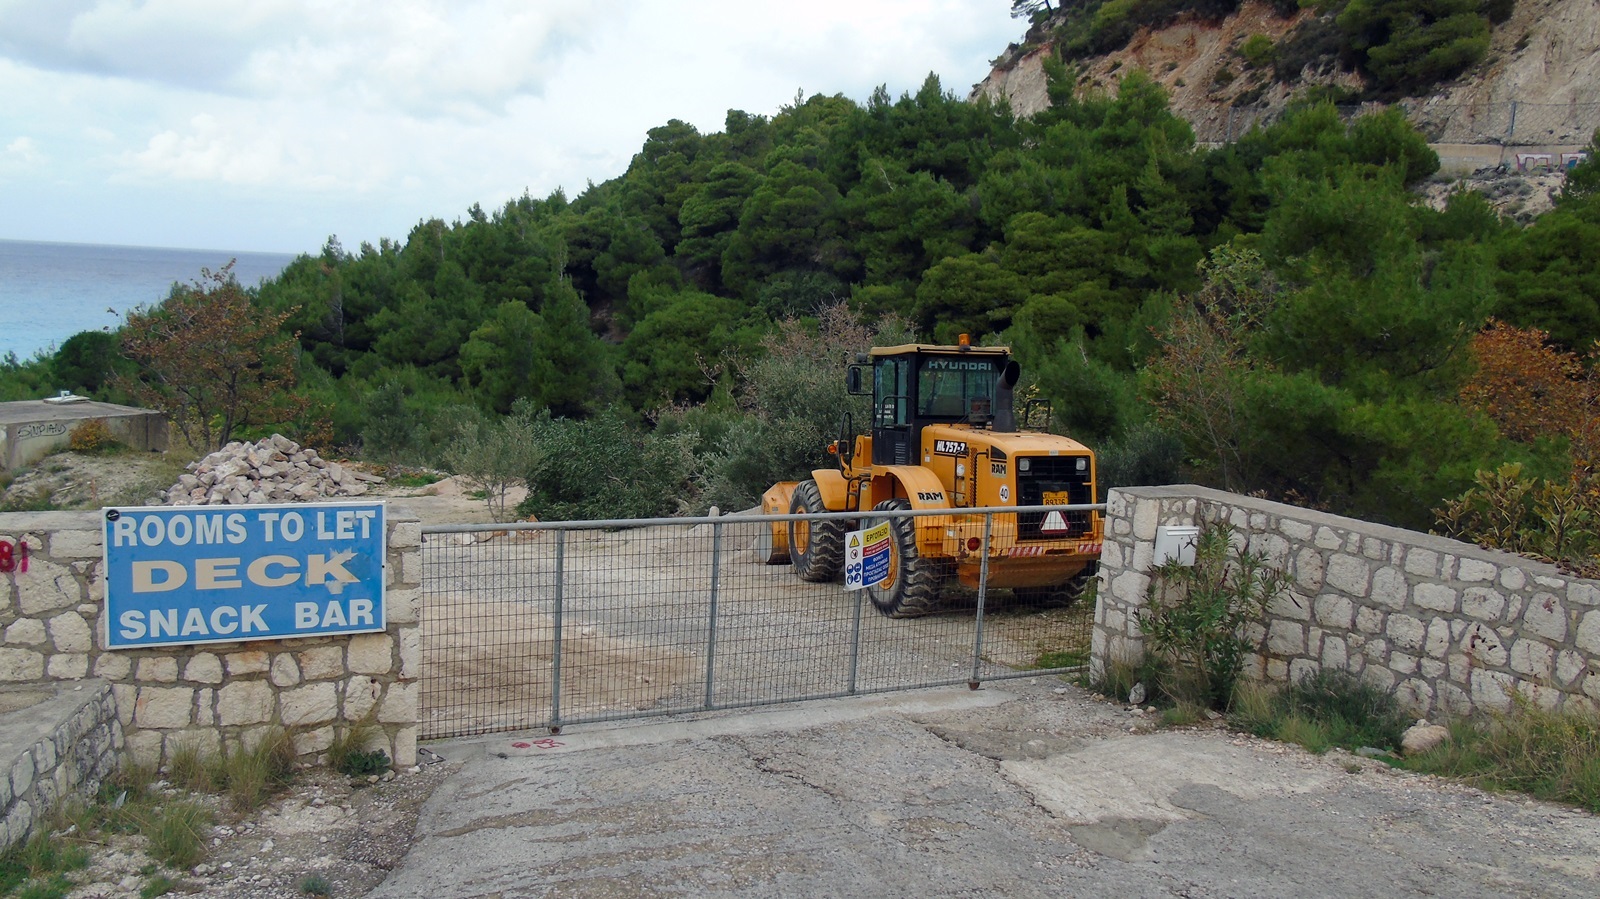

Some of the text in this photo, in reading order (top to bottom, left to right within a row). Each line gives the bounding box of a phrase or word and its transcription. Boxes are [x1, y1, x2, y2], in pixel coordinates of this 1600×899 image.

[928, 360, 992, 370] HYUNDAI
[991, 463, 1007, 475] RAM
[917, 492, 944, 501] RAM
[1000, 488, 1008, 500] 40
[113, 510, 376, 547] ROOMS TO LET
[132, 552, 361, 593] DECK
[119, 599, 375, 640] SNACK BAR
